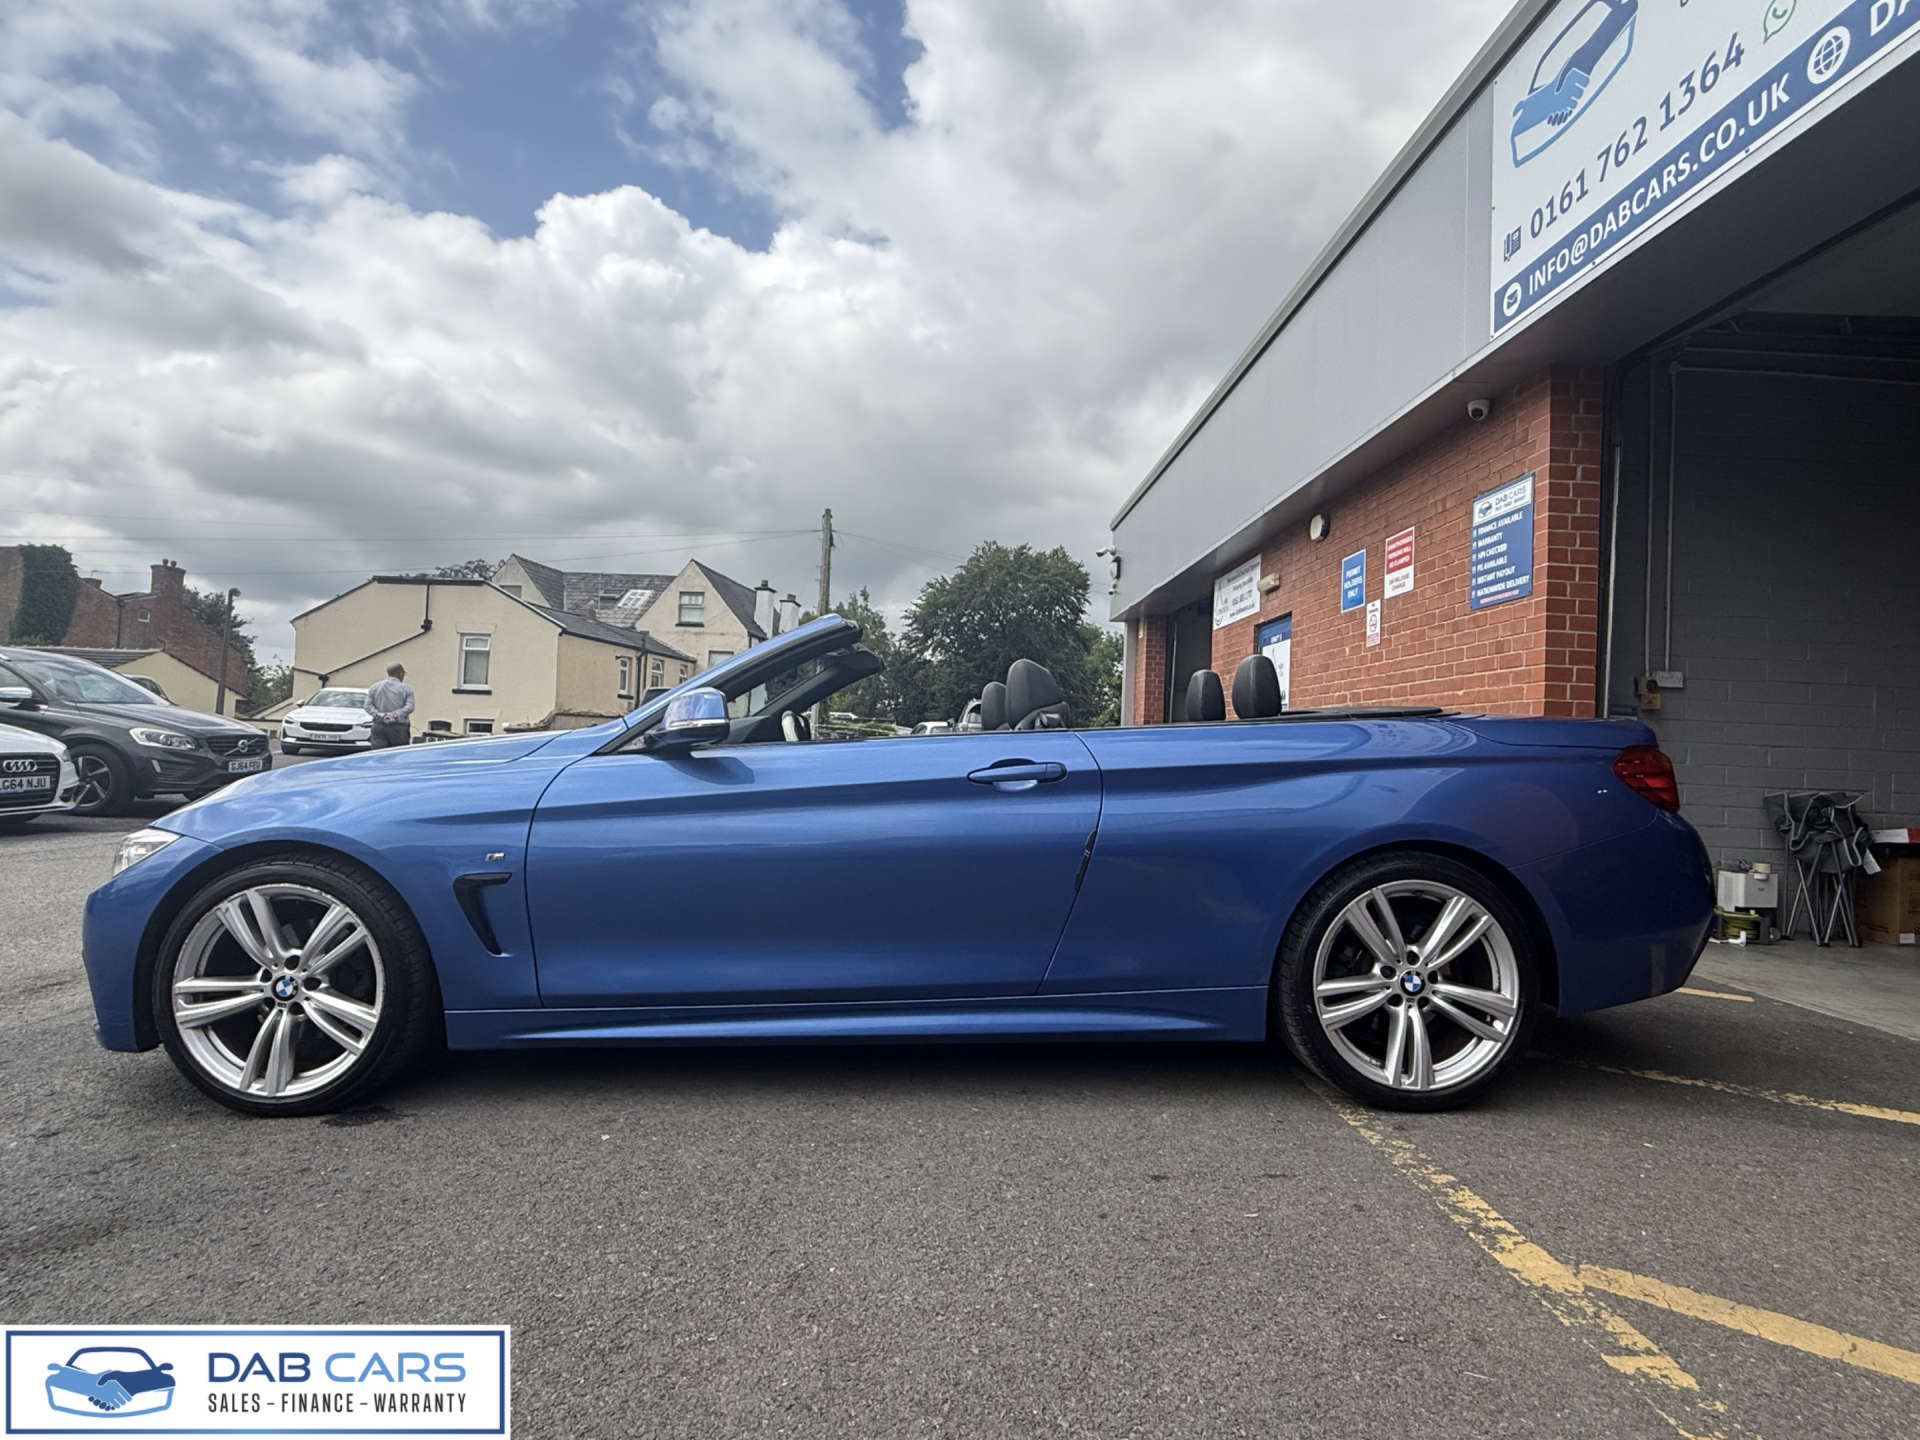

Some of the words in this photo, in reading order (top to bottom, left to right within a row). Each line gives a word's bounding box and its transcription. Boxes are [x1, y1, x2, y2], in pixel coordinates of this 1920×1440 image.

[1870, 0, 1911, 37] D
[1529, 73, 1790, 295] INFO@DABCARS.CO.UK
[1530, 168, 1588, 238] 0161
[1597, 117, 1647, 182] 762
[1659, 32, 1745, 131] 1364
[26, 777, 47, 788] NJU
